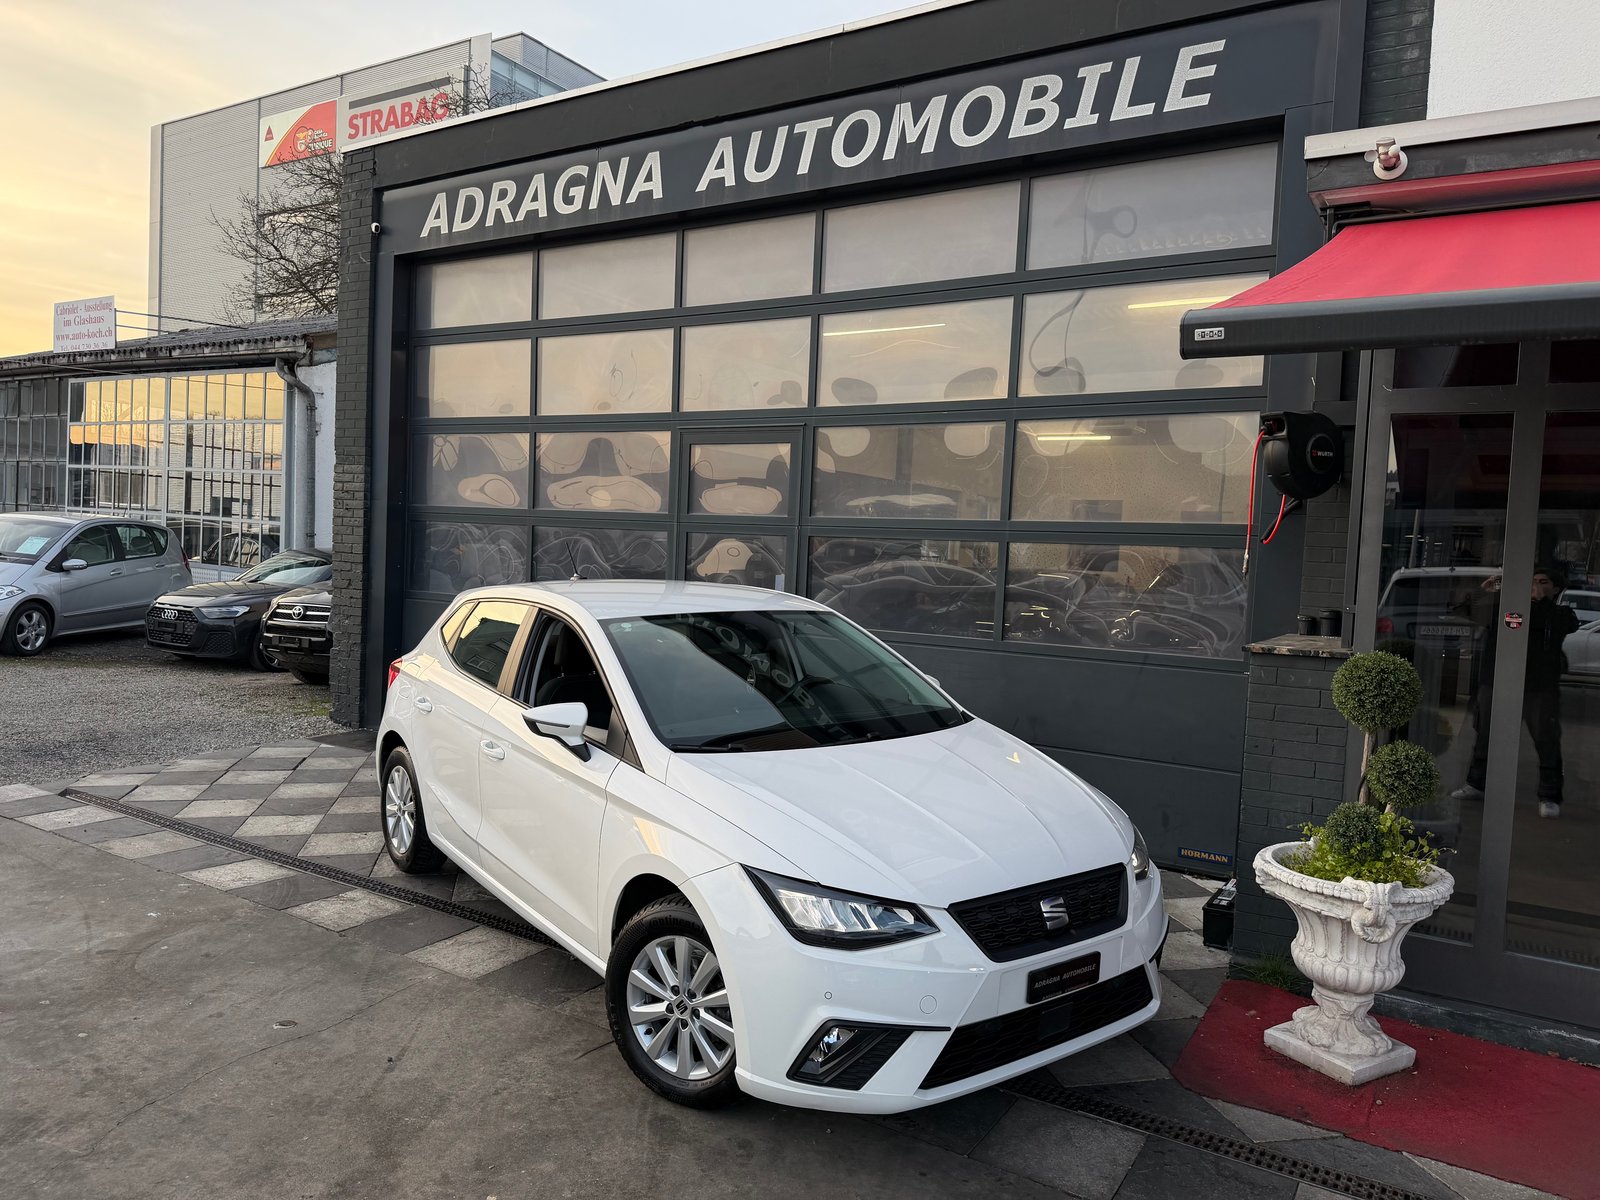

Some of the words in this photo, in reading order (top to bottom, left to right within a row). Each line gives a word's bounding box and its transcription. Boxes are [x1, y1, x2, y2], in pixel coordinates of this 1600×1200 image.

[347, 92, 450, 140] STRABAG
[420, 150, 664, 238] ADRAGNA
[695, 39, 1226, 192] AUTOMOBILE
[63, 317, 72, 327] im
[74, 314, 105, 326] Glashaus
[56, 327, 113, 342] www.auto-koch.ch
[1034, 975, 1060, 988] ADRAGNA
[1062, 963, 1097, 980] AUTOMOBILE
